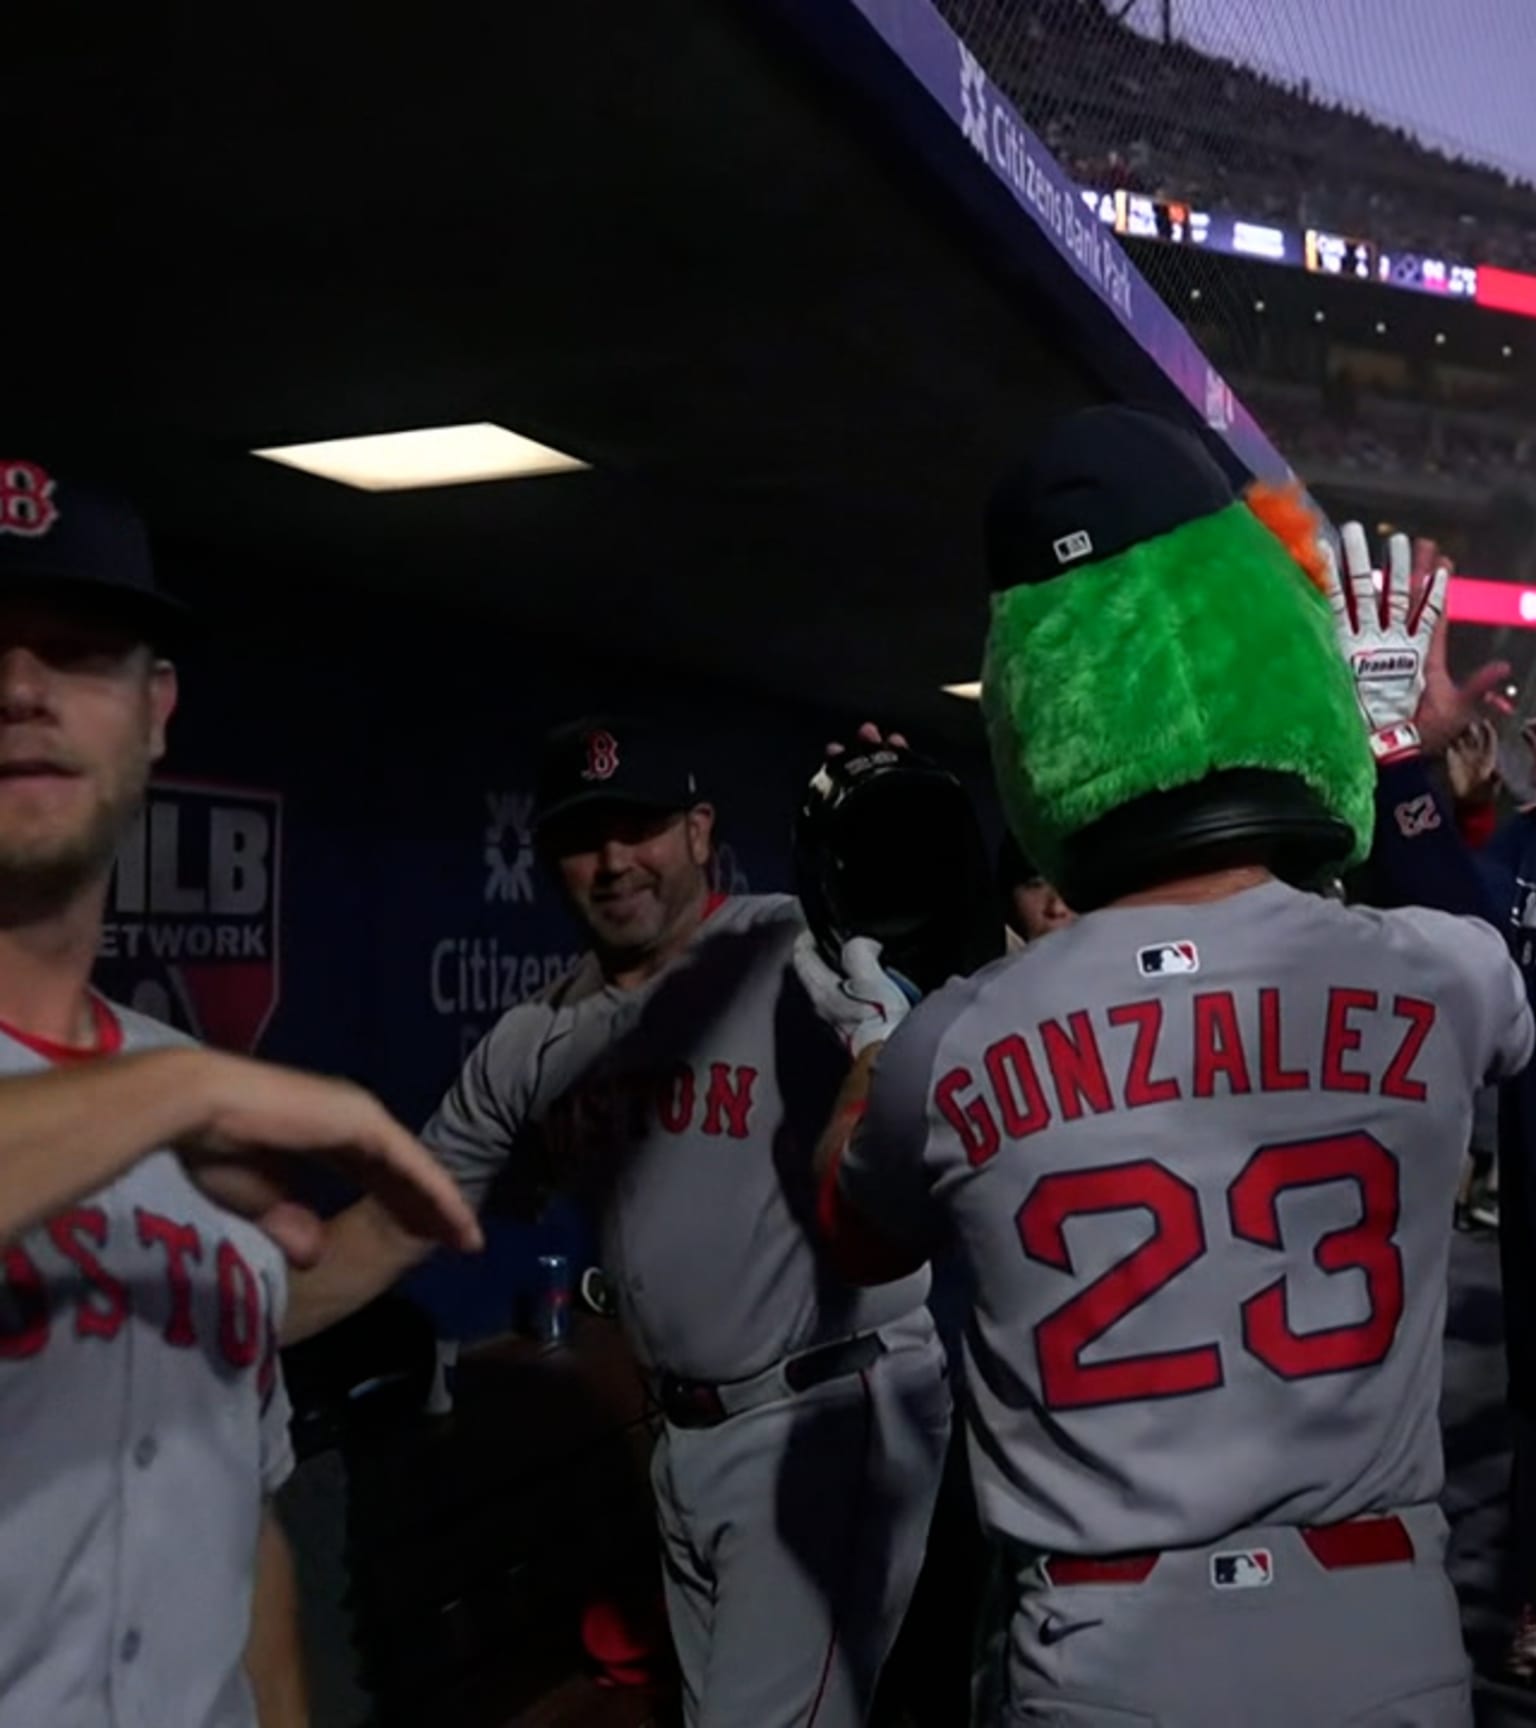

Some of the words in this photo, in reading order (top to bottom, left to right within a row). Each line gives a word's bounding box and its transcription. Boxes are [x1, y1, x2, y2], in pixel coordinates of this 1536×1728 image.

[993, 104, 1063, 237] Citizens
[1064, 191, 1103, 282] Bank
[1103, 236, 1134, 320] Park
[0, 457, 62, 539] B
[579, 728, 621, 783] B
[100, 922, 269, 959] ETWORK
[933, 987, 1437, 1167] GONZALEZ
[0, 1205, 276, 1415] OSTO
[1014, 1130, 1405, 1412] 23
